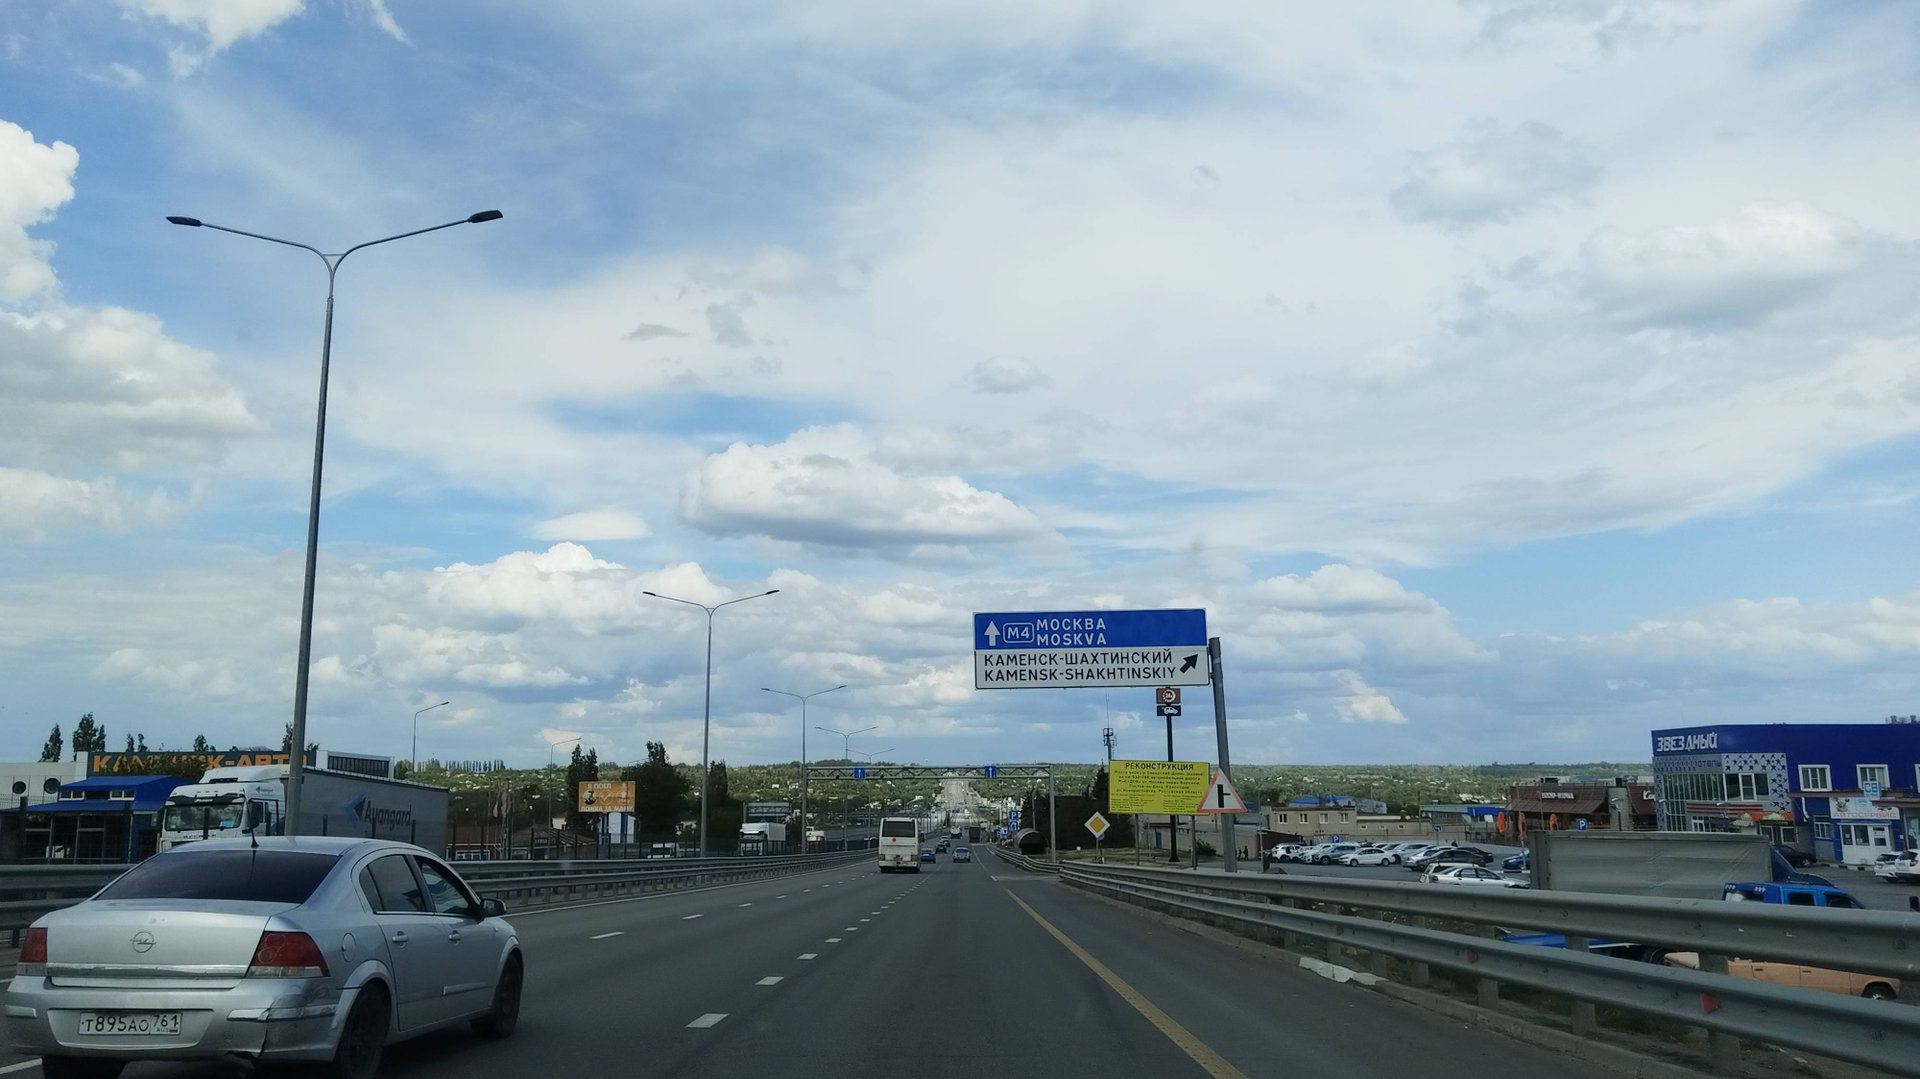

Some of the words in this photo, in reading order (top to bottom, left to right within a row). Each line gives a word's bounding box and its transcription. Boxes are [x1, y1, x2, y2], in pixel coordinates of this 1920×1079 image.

[1036, 618, 1106, 631] МОСКВА
[1036, 632, 1107, 646] MOSKVA
[984, 648, 1172, 667] КАМЕНСК-ШАХТИНСКИЙ
[984, 667, 1176, 682] KAMENSK-SHAKHTINSKIY
[1656, 732, 1718, 752] ЗВЕЗДНЫЙ
[1125, 762, 1194, 772] РЕКОНСТРУКЦИЯ
[152, 1015, 179, 1028] 761
